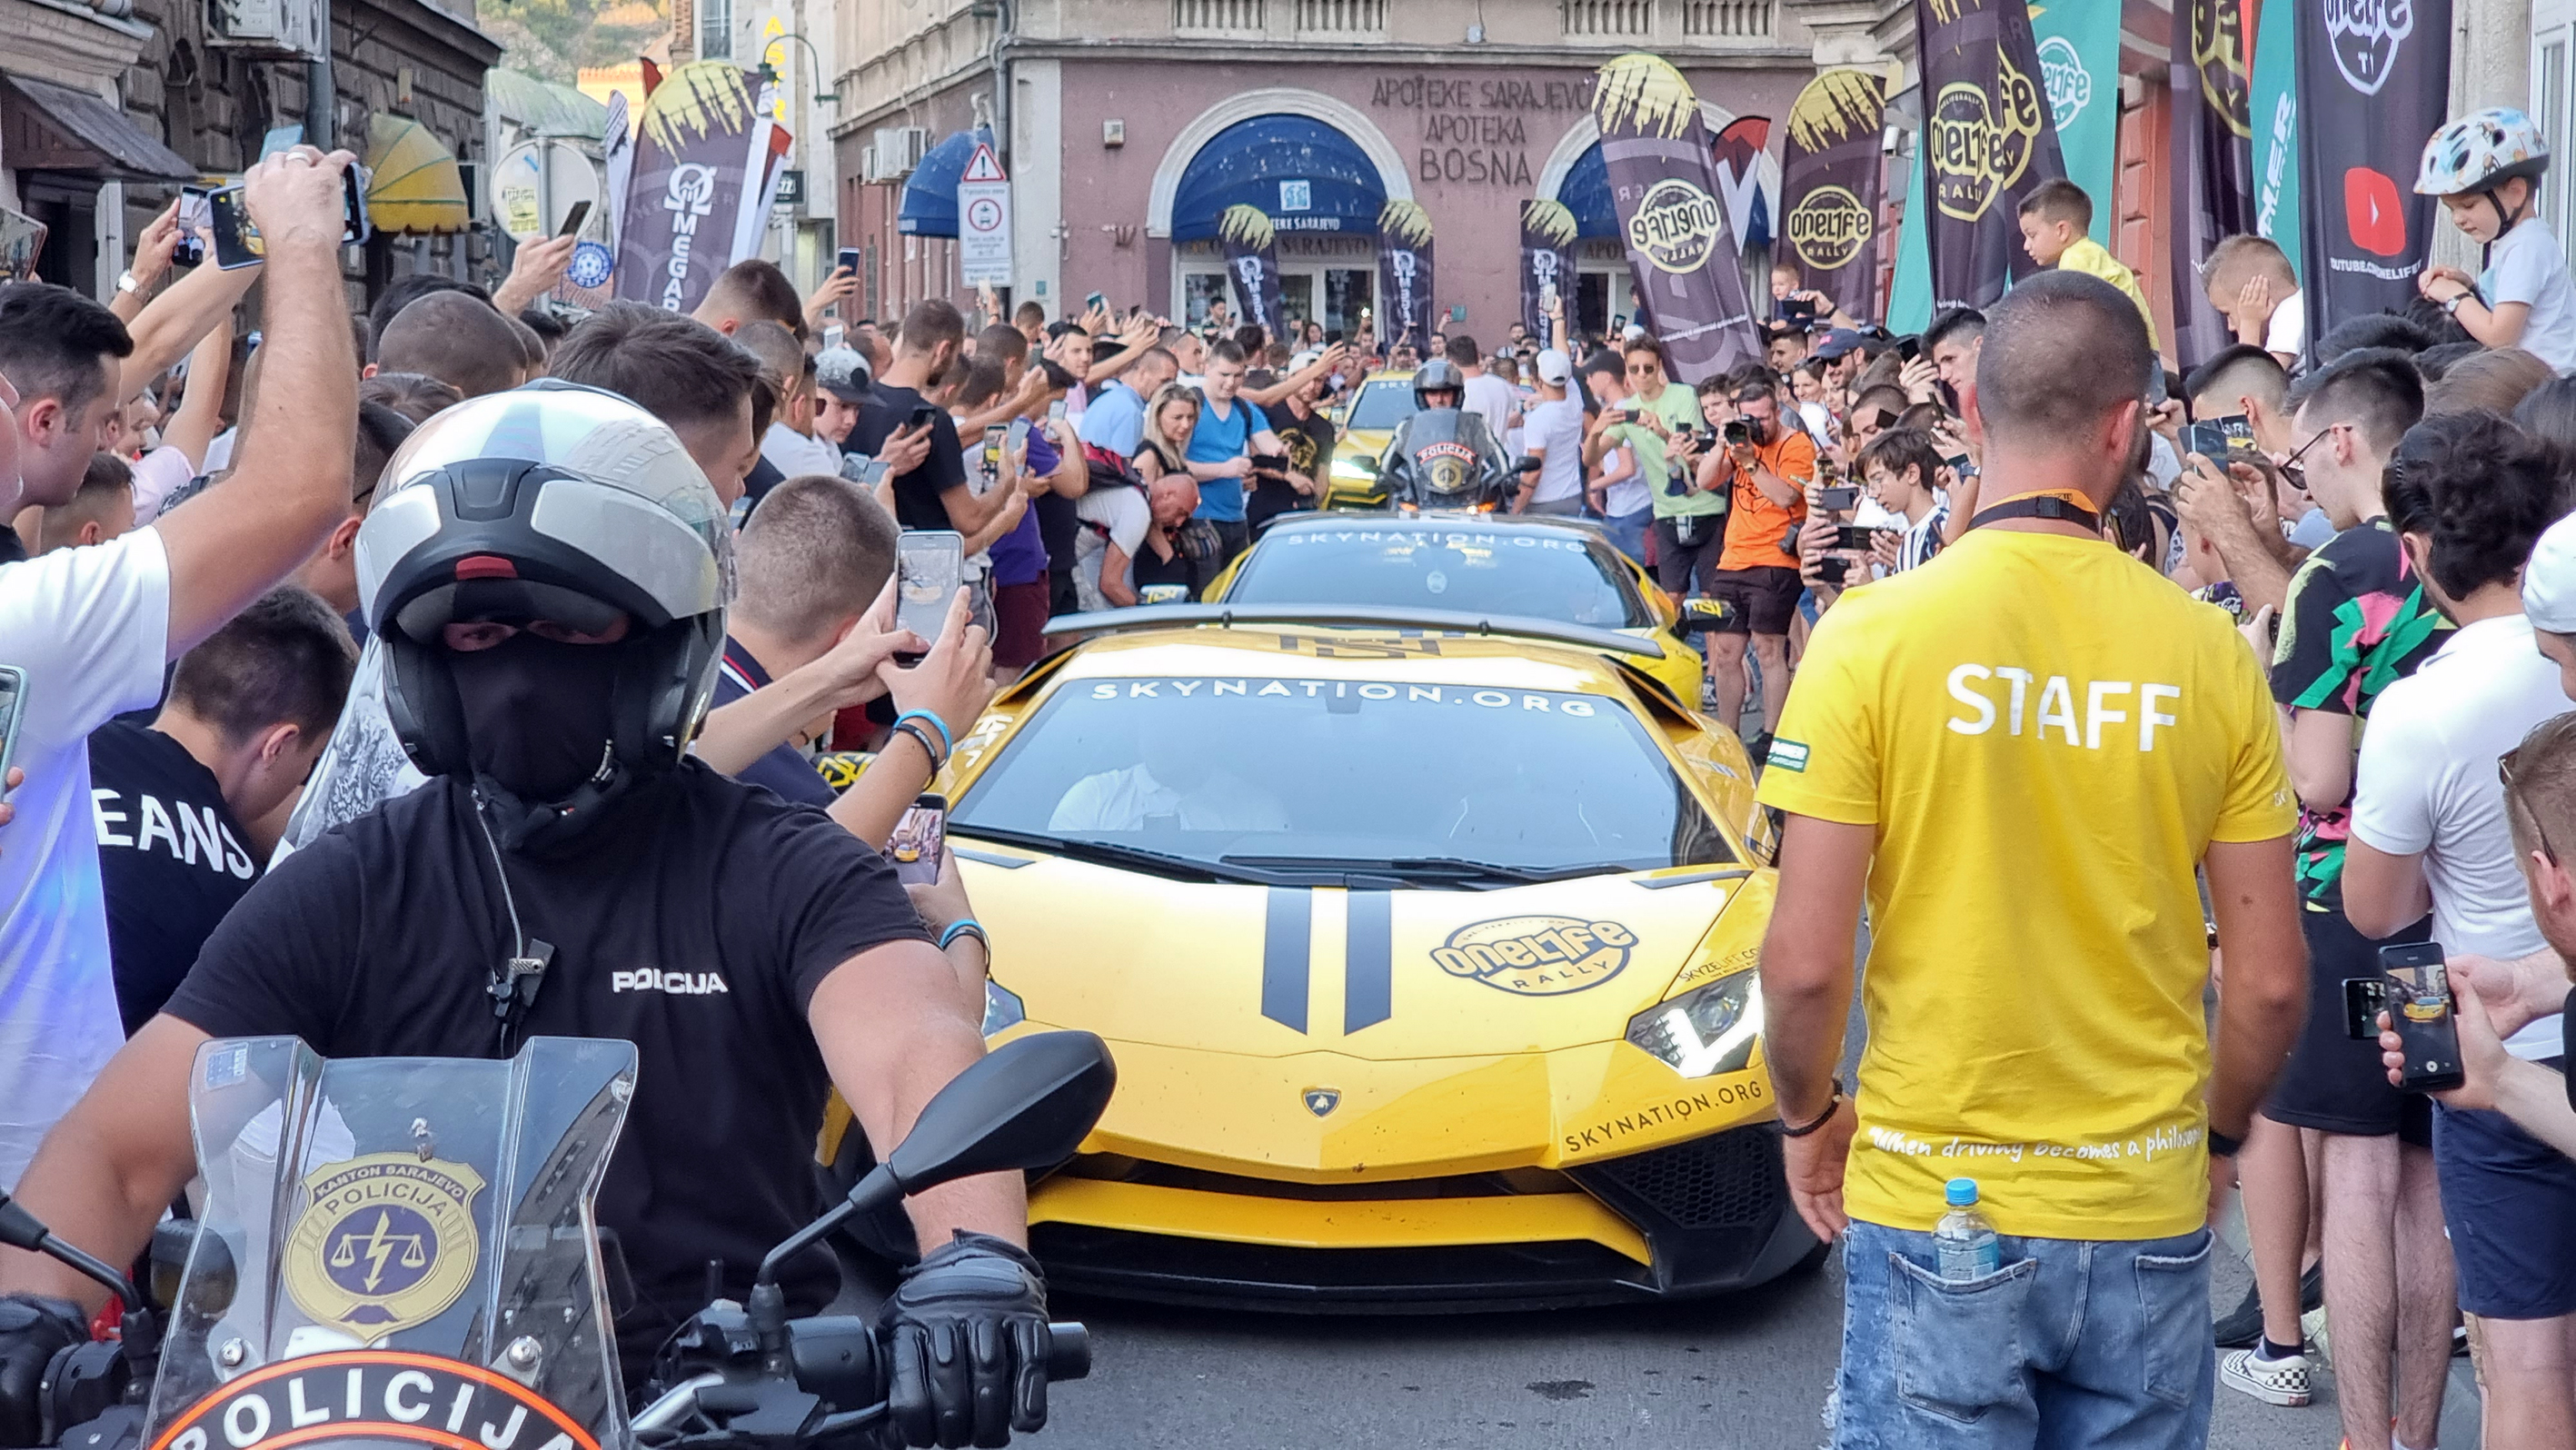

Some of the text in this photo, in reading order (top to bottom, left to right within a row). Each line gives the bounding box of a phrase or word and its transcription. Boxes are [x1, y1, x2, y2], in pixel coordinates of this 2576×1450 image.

[1372, 78, 1593, 111] APOTEKE SARAJEVO
[1425, 114, 1527, 144] APOTEKA
[1418, 147, 1533, 186] BOSNA
[1805, 245, 1850, 257] RALLY
[1288, 531, 1586, 552] SKYNATION.ORG
[1090, 680, 1596, 718] SKYNATION.ORG
[1946, 662, 2181, 751] STAFF
[1512, 960, 1608, 988] RALLY
[1566, 1080, 1762, 1152] SKYNATION.ORG
[1941, 1136, 2024, 1163] driving
[2033, 1141, 2121, 1159] becomes
[2127, 1140, 2141, 1157] a
[316, 1165, 464, 1198] KANTON SARAJEVO
[323, 1182, 448, 1217] POLICIJA
